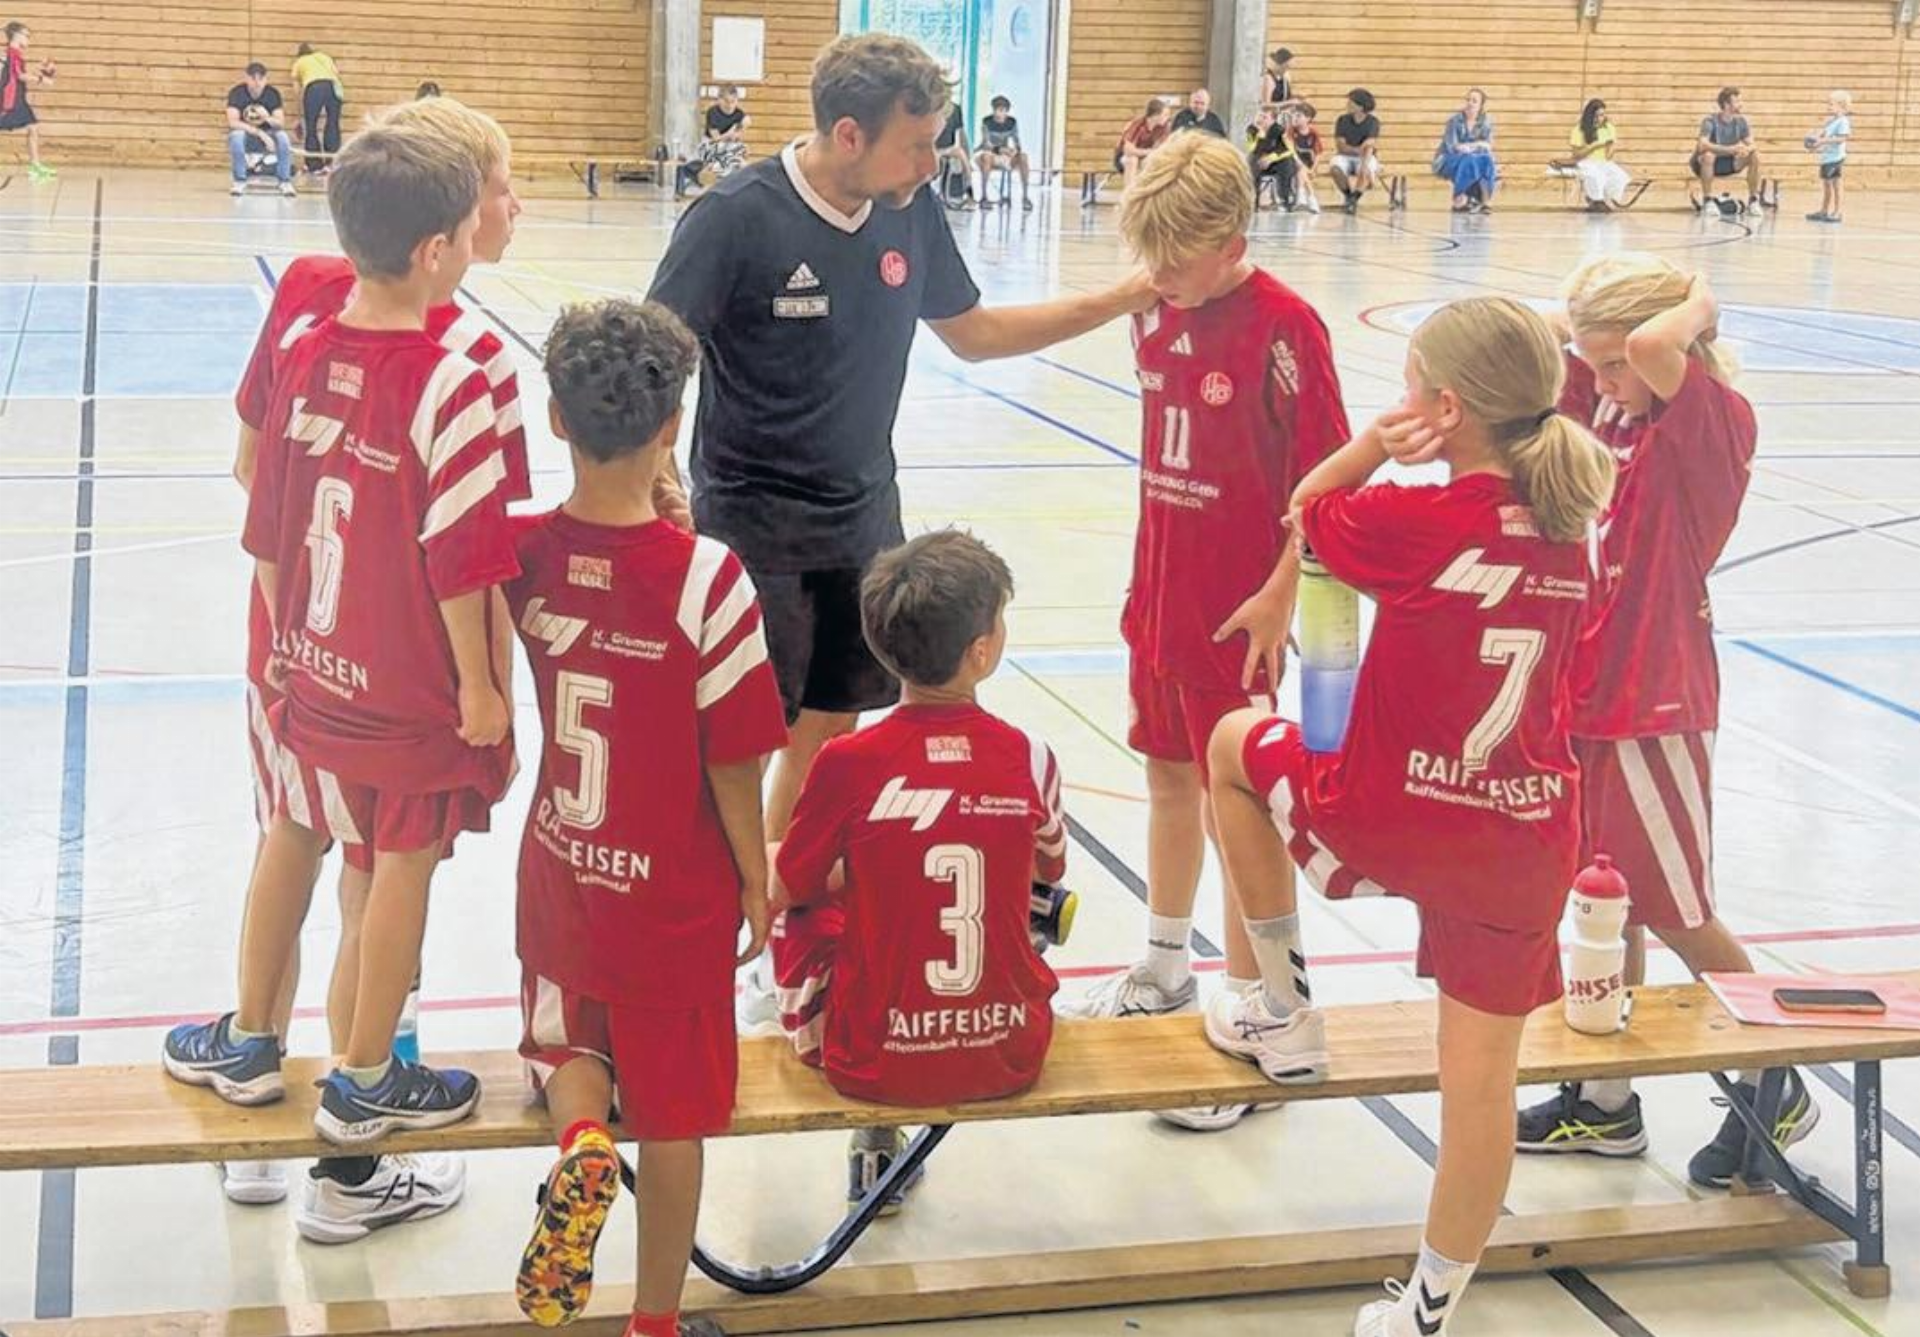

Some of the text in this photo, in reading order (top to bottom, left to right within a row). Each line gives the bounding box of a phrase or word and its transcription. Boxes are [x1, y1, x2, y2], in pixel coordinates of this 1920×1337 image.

[1161, 406, 1190, 470] 11
[304, 476, 354, 636] 6
[552, 669, 614, 831] 5
[1462, 627, 1546, 771] 7
[536, 797, 651, 880] RAEISEN
[1407, 749, 1563, 806] RAIFEISEN
[924, 843, 985, 997] 3
